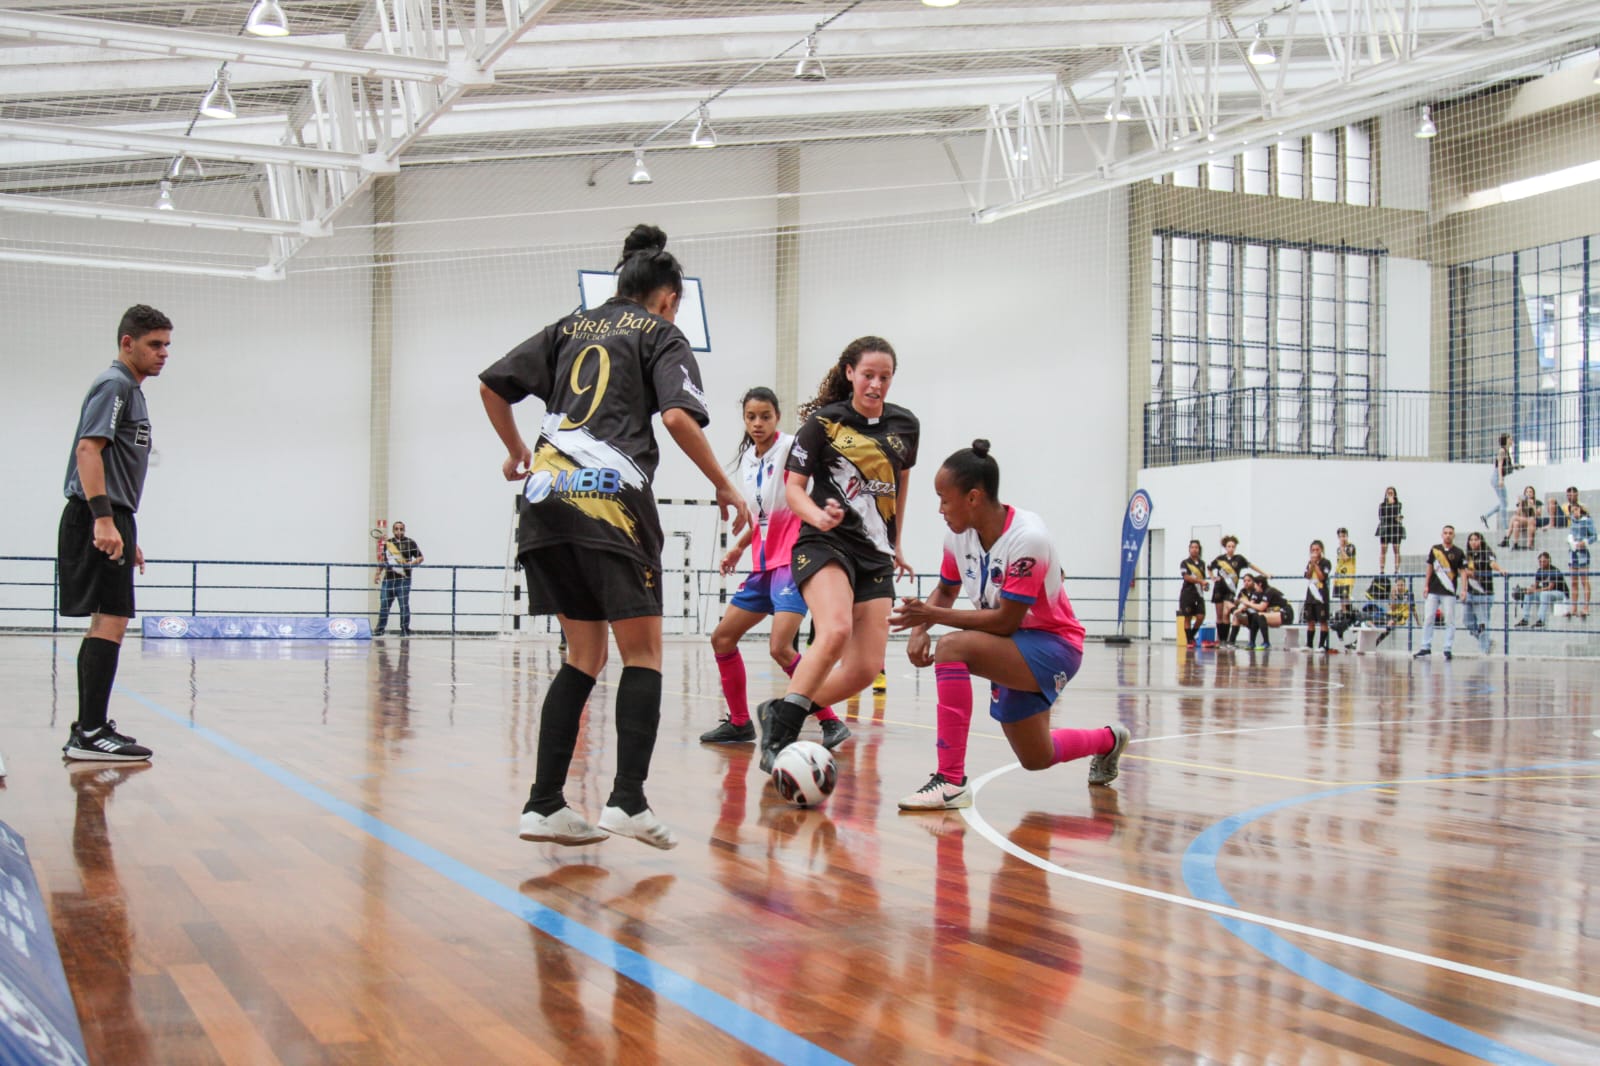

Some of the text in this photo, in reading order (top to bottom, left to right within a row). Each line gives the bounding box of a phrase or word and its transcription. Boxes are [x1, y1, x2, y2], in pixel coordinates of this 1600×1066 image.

[616, 312, 658, 334] Ball
[558, 344, 611, 431] 9
[554, 467, 621, 493] MBB
